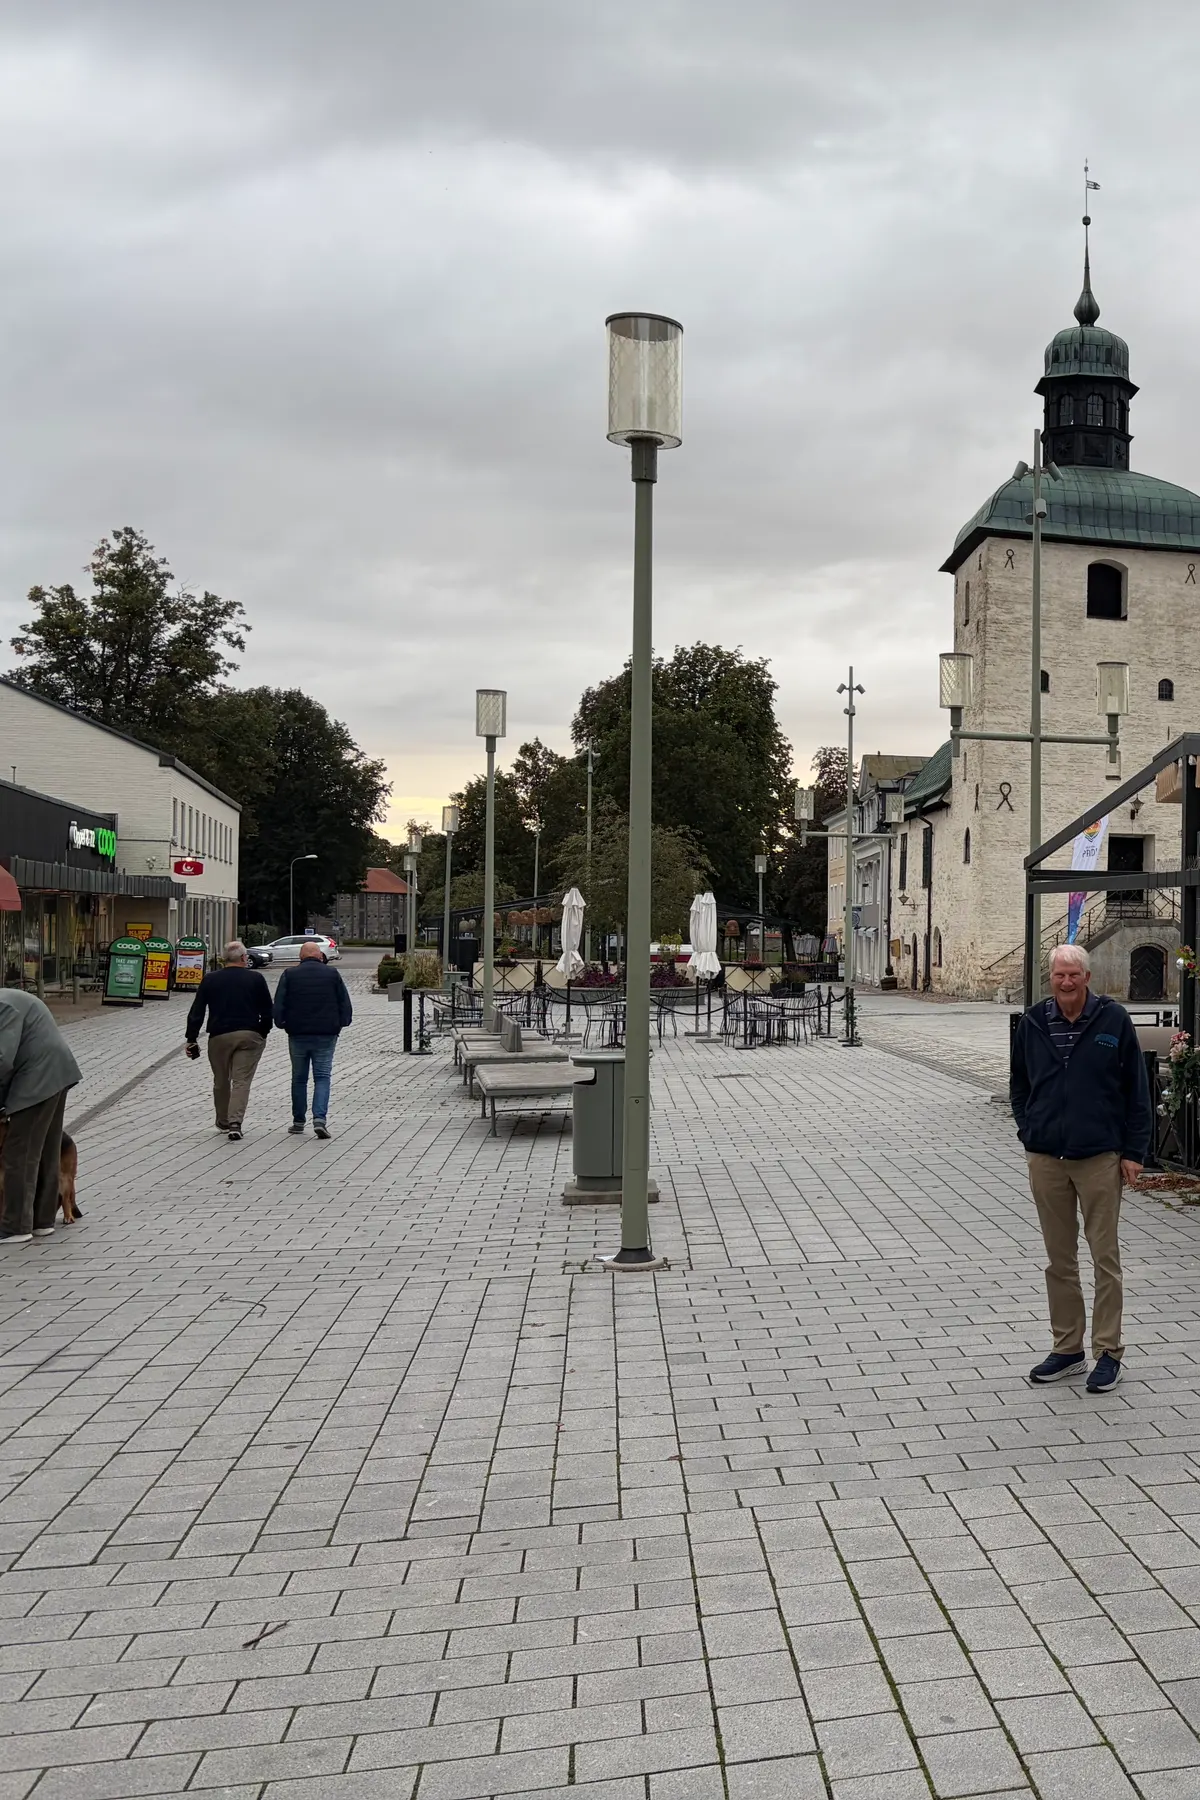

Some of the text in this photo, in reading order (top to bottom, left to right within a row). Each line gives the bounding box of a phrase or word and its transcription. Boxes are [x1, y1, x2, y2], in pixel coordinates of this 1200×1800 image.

[97, 828, 116, 863] coop
[117, 943, 141, 951] coop
[145, 942, 169, 950] coop
[180, 941, 202, 949] coop
